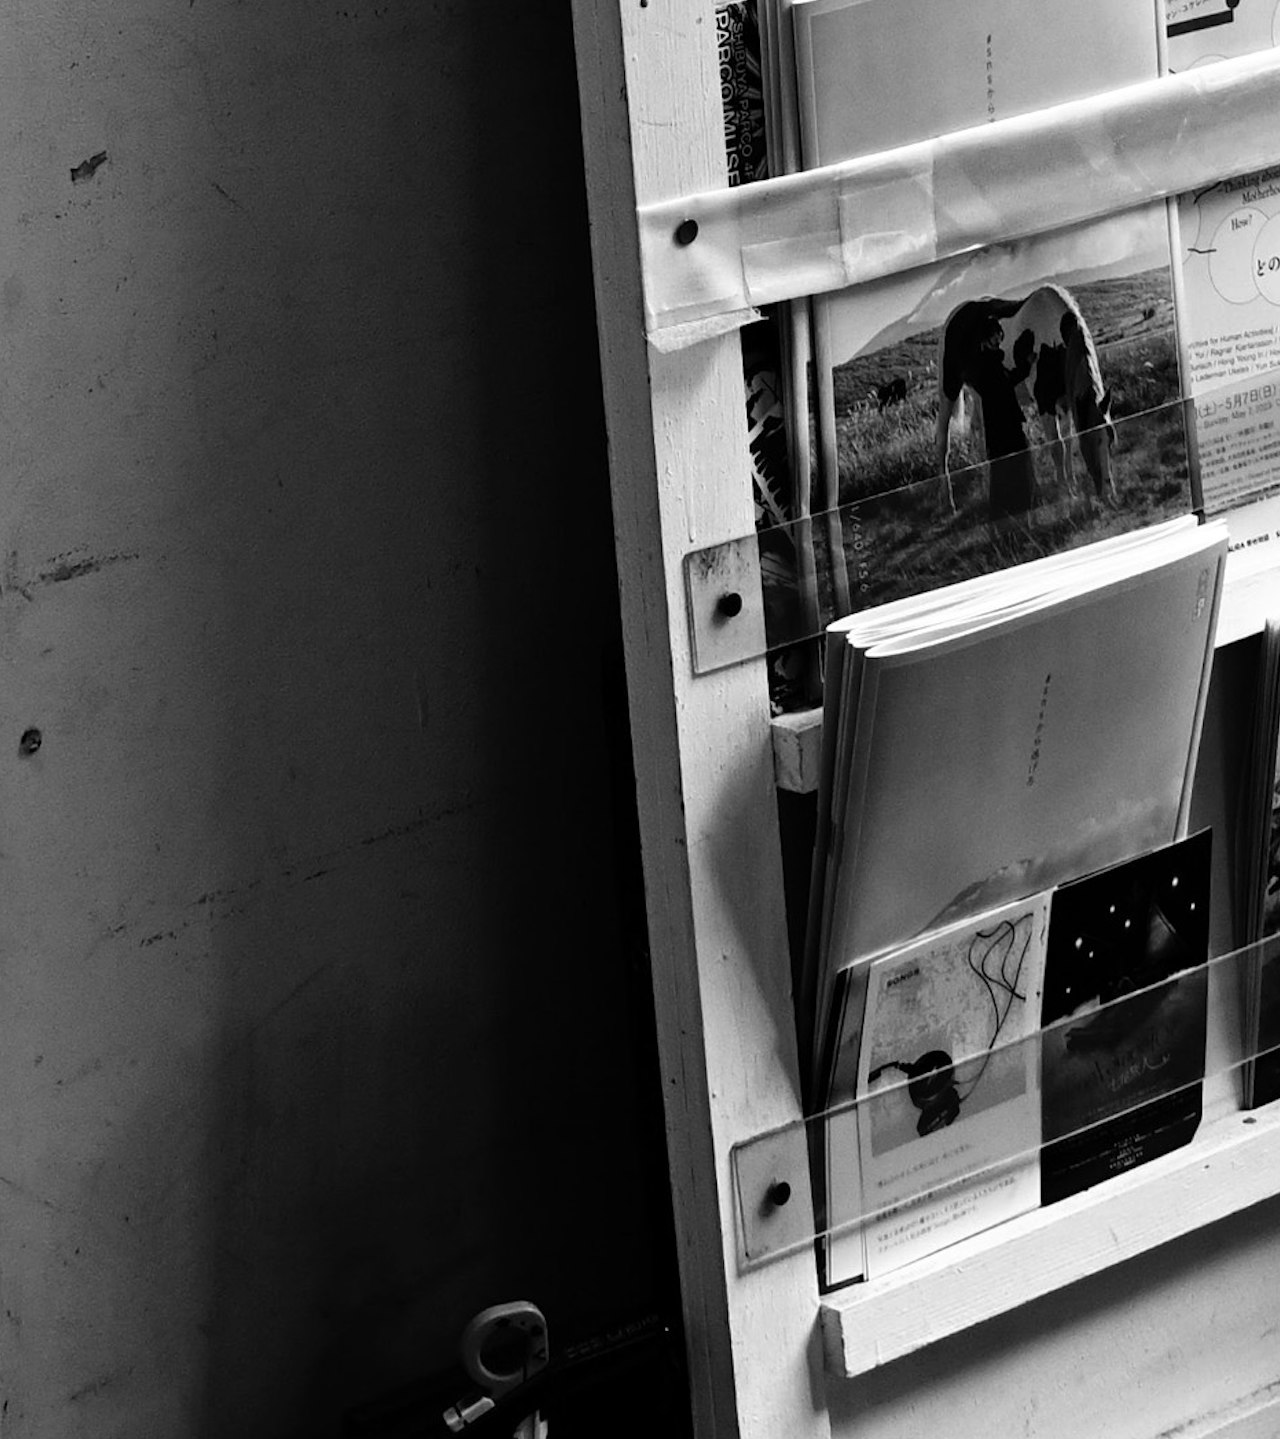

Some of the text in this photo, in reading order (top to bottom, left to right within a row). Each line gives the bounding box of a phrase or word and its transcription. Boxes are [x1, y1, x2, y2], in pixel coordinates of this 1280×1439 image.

[734, 22, 748, 96] SHIBUYA
[723, 110, 740, 186] MUSE
[740, 99, 753, 157] PARCO
[1231, 213, 1253, 231] How?
